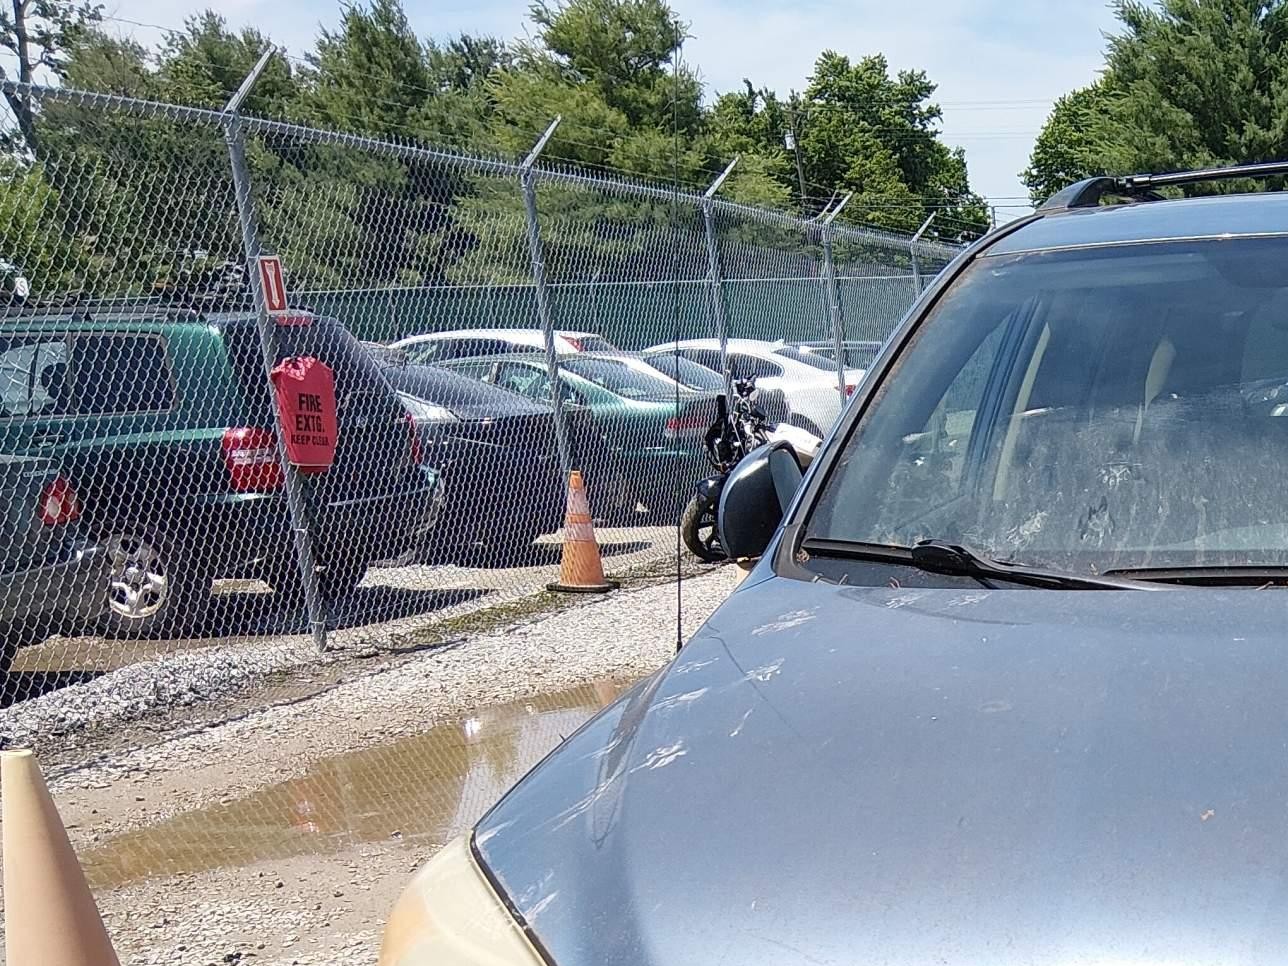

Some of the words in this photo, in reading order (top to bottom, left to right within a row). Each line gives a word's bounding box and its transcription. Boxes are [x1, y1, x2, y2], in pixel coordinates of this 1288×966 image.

[299, 393, 322, 413] FIRE
[296, 415, 325, 432] EXTG.
[291, 435, 310, 444] KEEP
[312, 436, 329, 446] CLEAR
